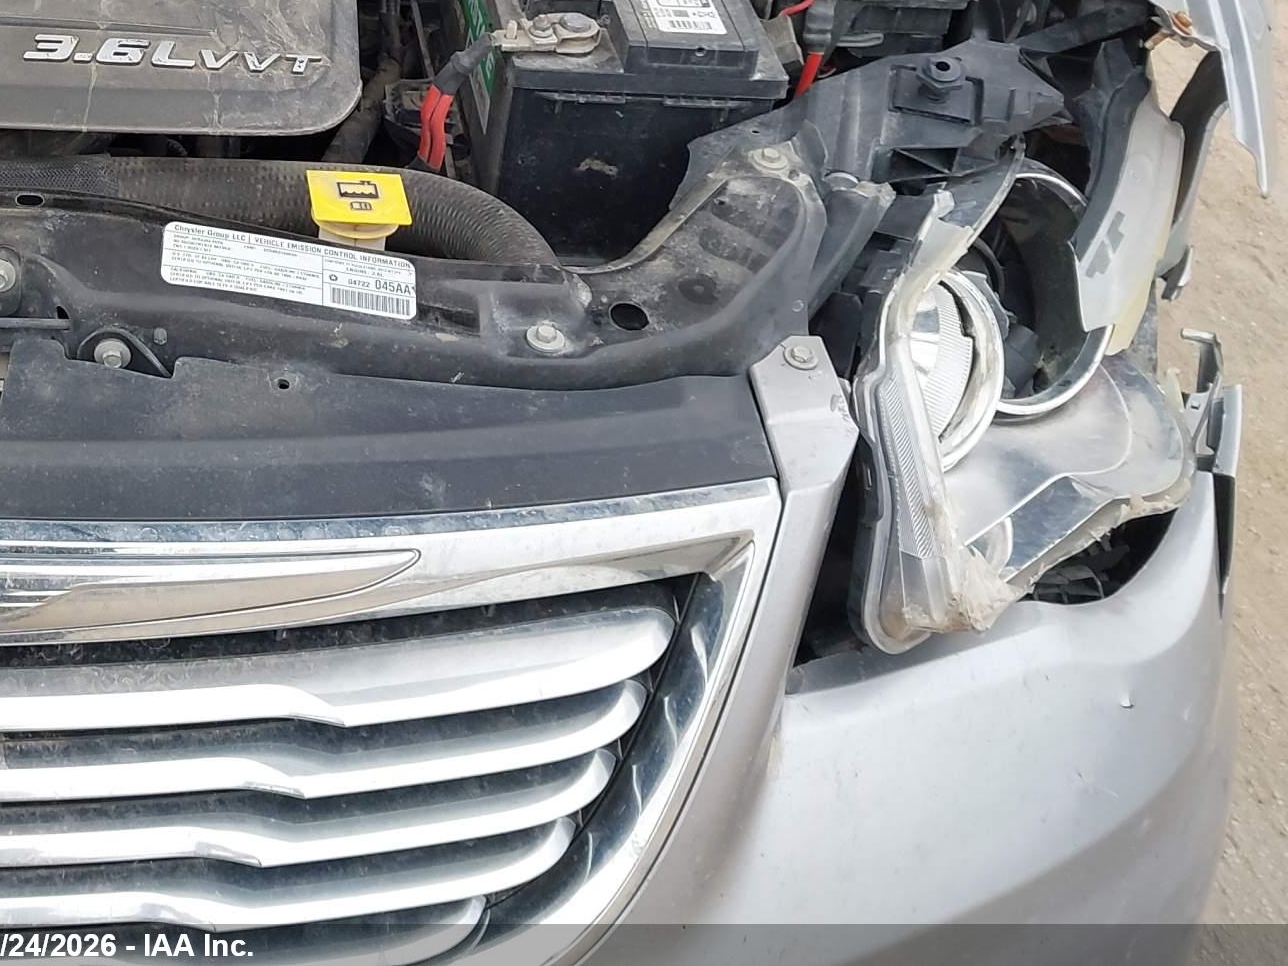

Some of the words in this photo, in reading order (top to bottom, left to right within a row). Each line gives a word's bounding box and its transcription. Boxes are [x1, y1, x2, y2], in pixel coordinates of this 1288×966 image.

[174, 224, 205, 236] Chrysler
[207, 229, 230, 240] Group
[232, 233, 246, 242] LLC
[254, 236, 285, 248] VEHICLE
[287, 242, 322, 254] EMISSION
[324, 248, 358, 260] CONTROL
[359, 255, 412, 269] INFORMATION
[348, 279, 370, 288] 04722
